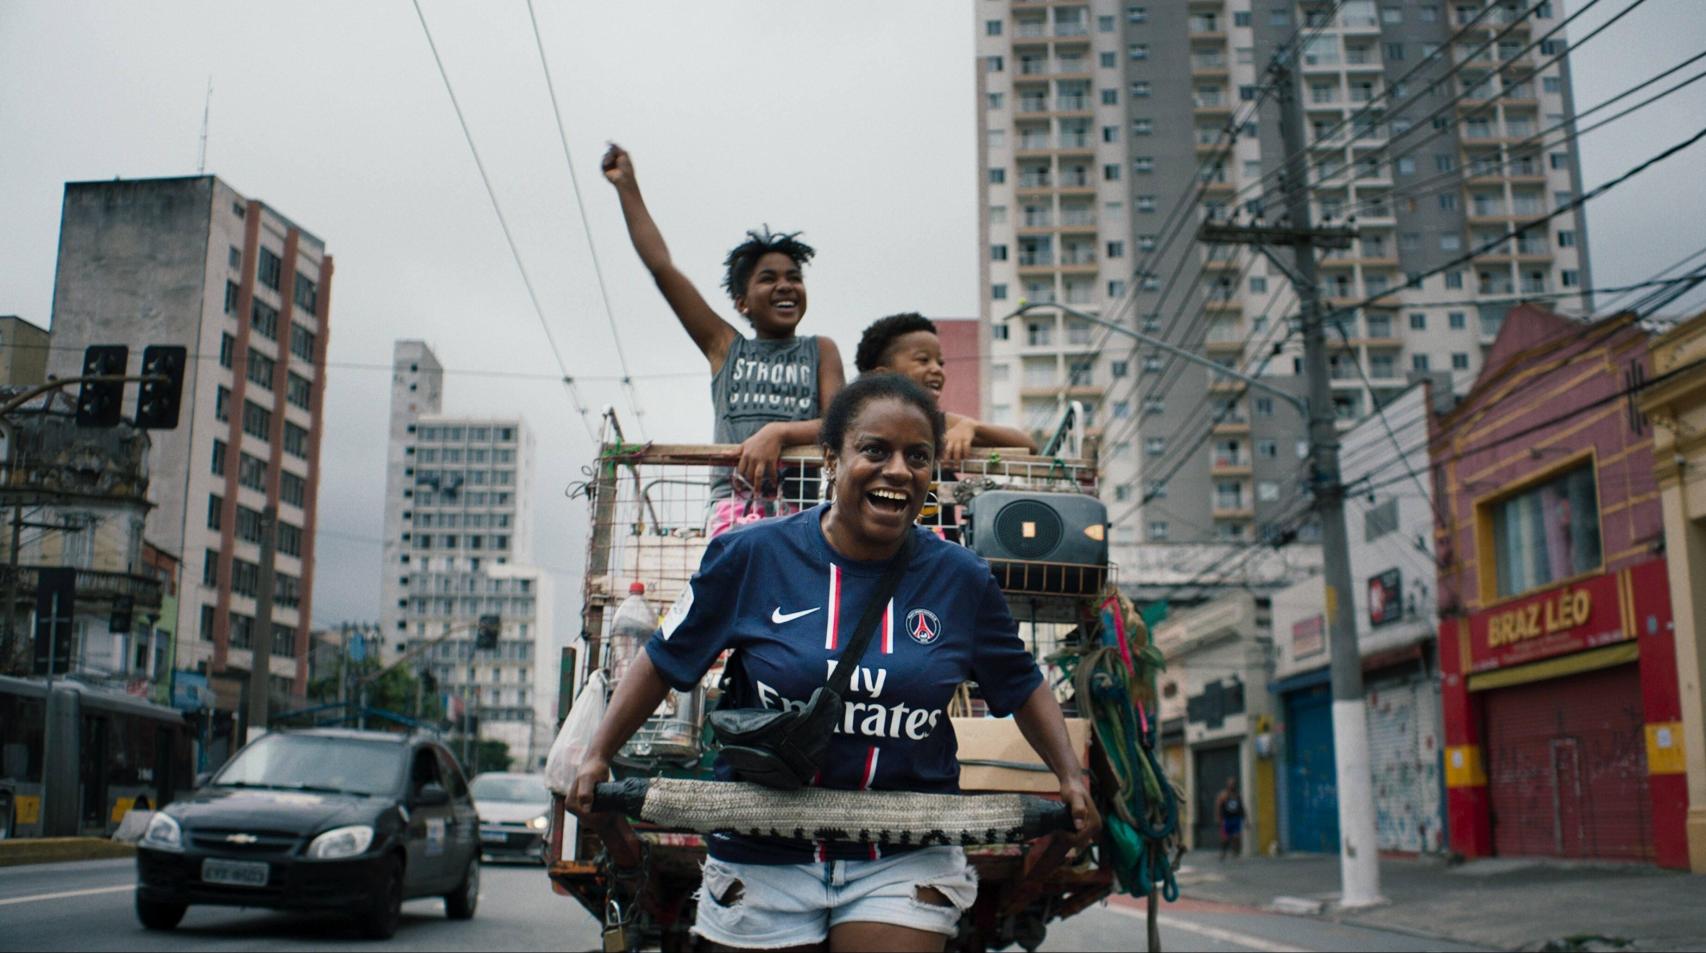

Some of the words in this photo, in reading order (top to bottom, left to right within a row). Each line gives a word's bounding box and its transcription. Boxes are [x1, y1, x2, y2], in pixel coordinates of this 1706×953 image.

[733, 357, 811, 386] STRONG
[1487, 603, 1542, 648] BRAZ
[1545, 586, 1592, 632] LÉO
